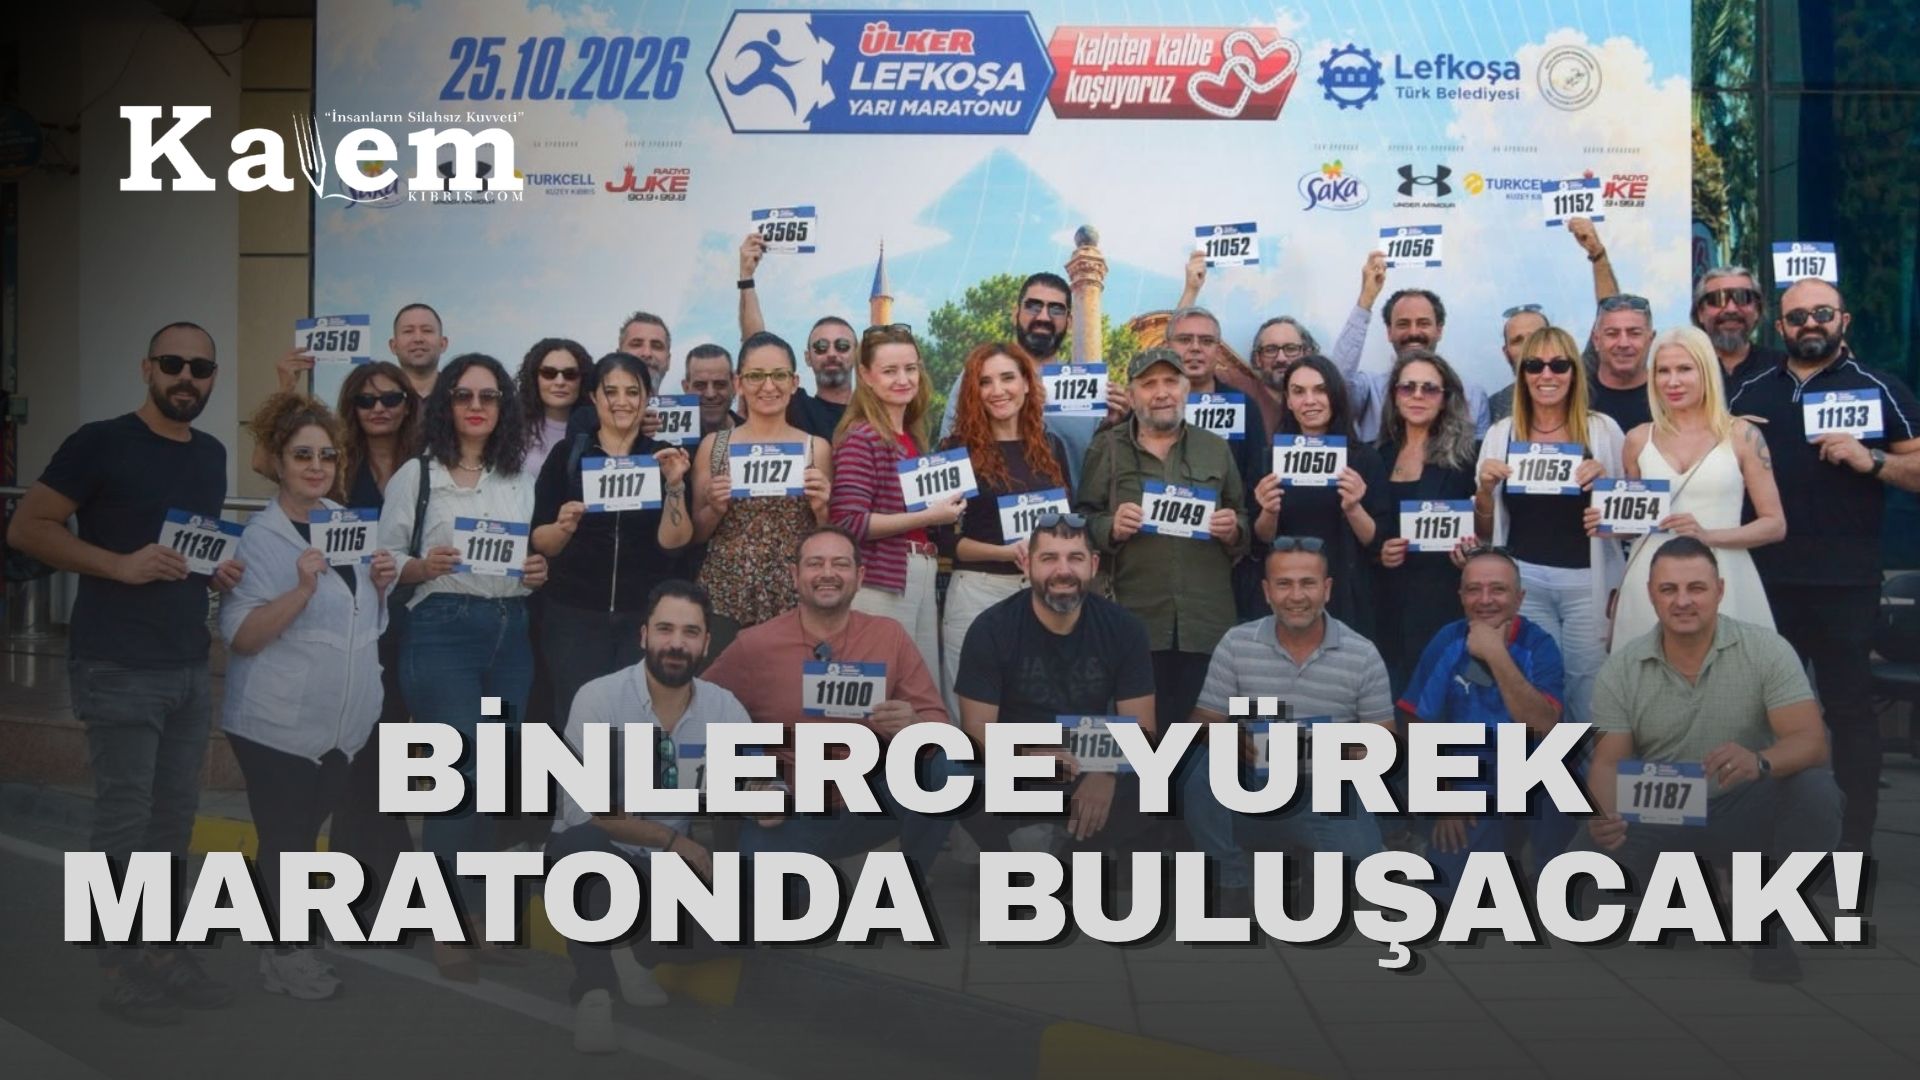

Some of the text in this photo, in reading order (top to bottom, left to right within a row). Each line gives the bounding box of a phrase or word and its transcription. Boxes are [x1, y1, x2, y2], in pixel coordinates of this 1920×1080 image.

[859, 21, 973, 55] ÜLKER
[1073, 31, 1211, 69] kalpten kalbe
[440, 36, 690, 101] 25.10.2026
[850, 62, 1026, 96] LEFKOŞA
[1395, 53, 1520, 85] Lefkoşa
[1065, 69, 1173, 106] koşuyoruz
[1395, 86, 1520, 102] Türk Belediyesi
[849, 99, 1021, 117] YARI MARATONU
[526, 174, 595, 186] TURKCELL
[605, 164, 690, 193] JUKE
[1485, 178, 1543, 190] TURKCE
[1553, 192, 1595, 216] 11152
[1205, 235, 1251, 259] 11052
[1387, 237, 1434, 259] 11056
[1786, 256, 1826, 277] 11157
[306, 330, 361, 352] 13519
[1054, 378, 1098, 400] 11124
[1193, 408, 1236, 430] 11123
[1817, 405, 1870, 429] 11133
[743, 459, 793, 484] 11127
[1283, 451, 1338, 474] 11050
[1517, 458, 1573, 482] 11053
[598, 472, 645, 499] 11117
[915, 466, 962, 498] 11119
[1150, 498, 1206, 527] 11049
[1603, 496, 1660, 521] 11054
[325, 526, 366, 553] 11115
[1415, 516, 1461, 540] 11151
[172, 529, 227, 562] 11130
[467, 536, 515, 563] 11116
[816, 680, 874, 707] 11100
[1633, 781, 1692, 810] 11187
